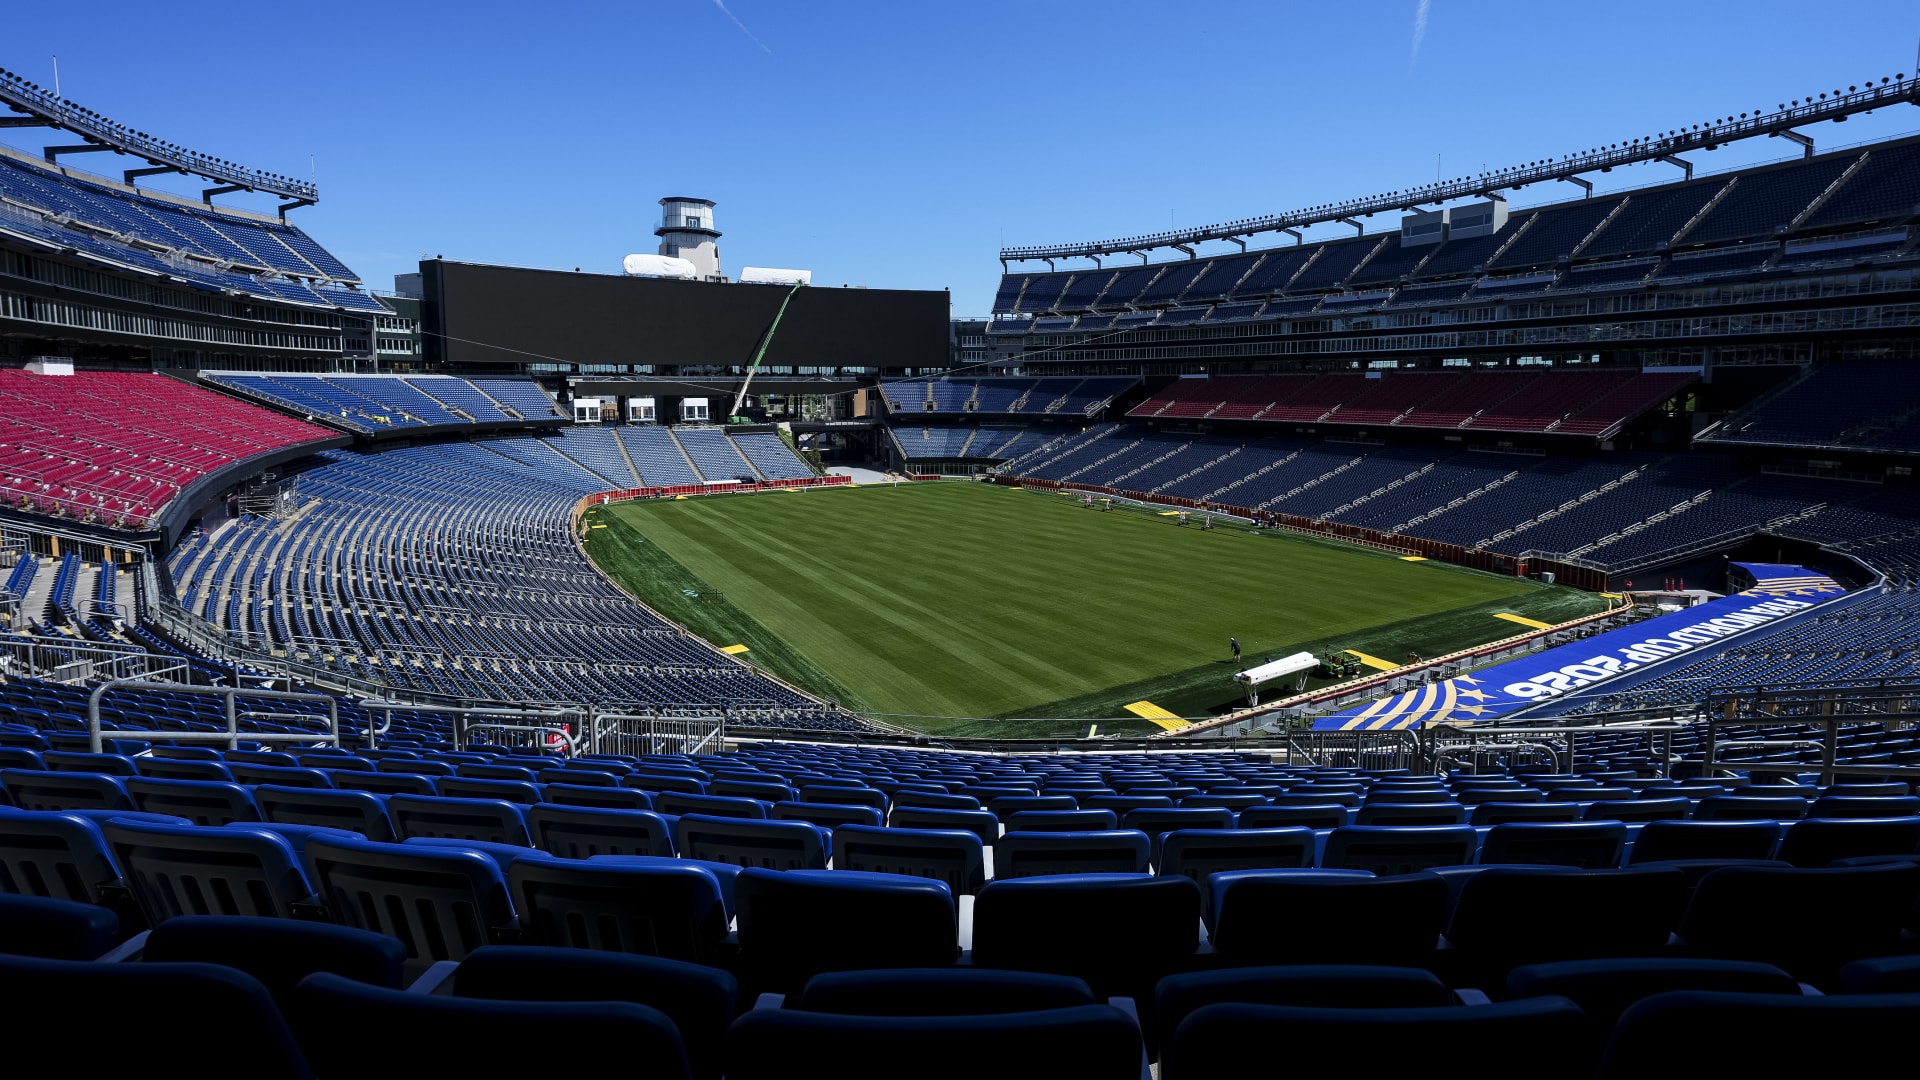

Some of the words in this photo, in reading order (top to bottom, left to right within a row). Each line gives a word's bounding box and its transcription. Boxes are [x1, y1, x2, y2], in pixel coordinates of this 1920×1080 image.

[1740, 598, 1815, 617] FIFA
[1668, 612, 1775, 644] WORLD
[1617, 638, 1694, 663] CUP
[1503, 655, 1639, 702] 2026
